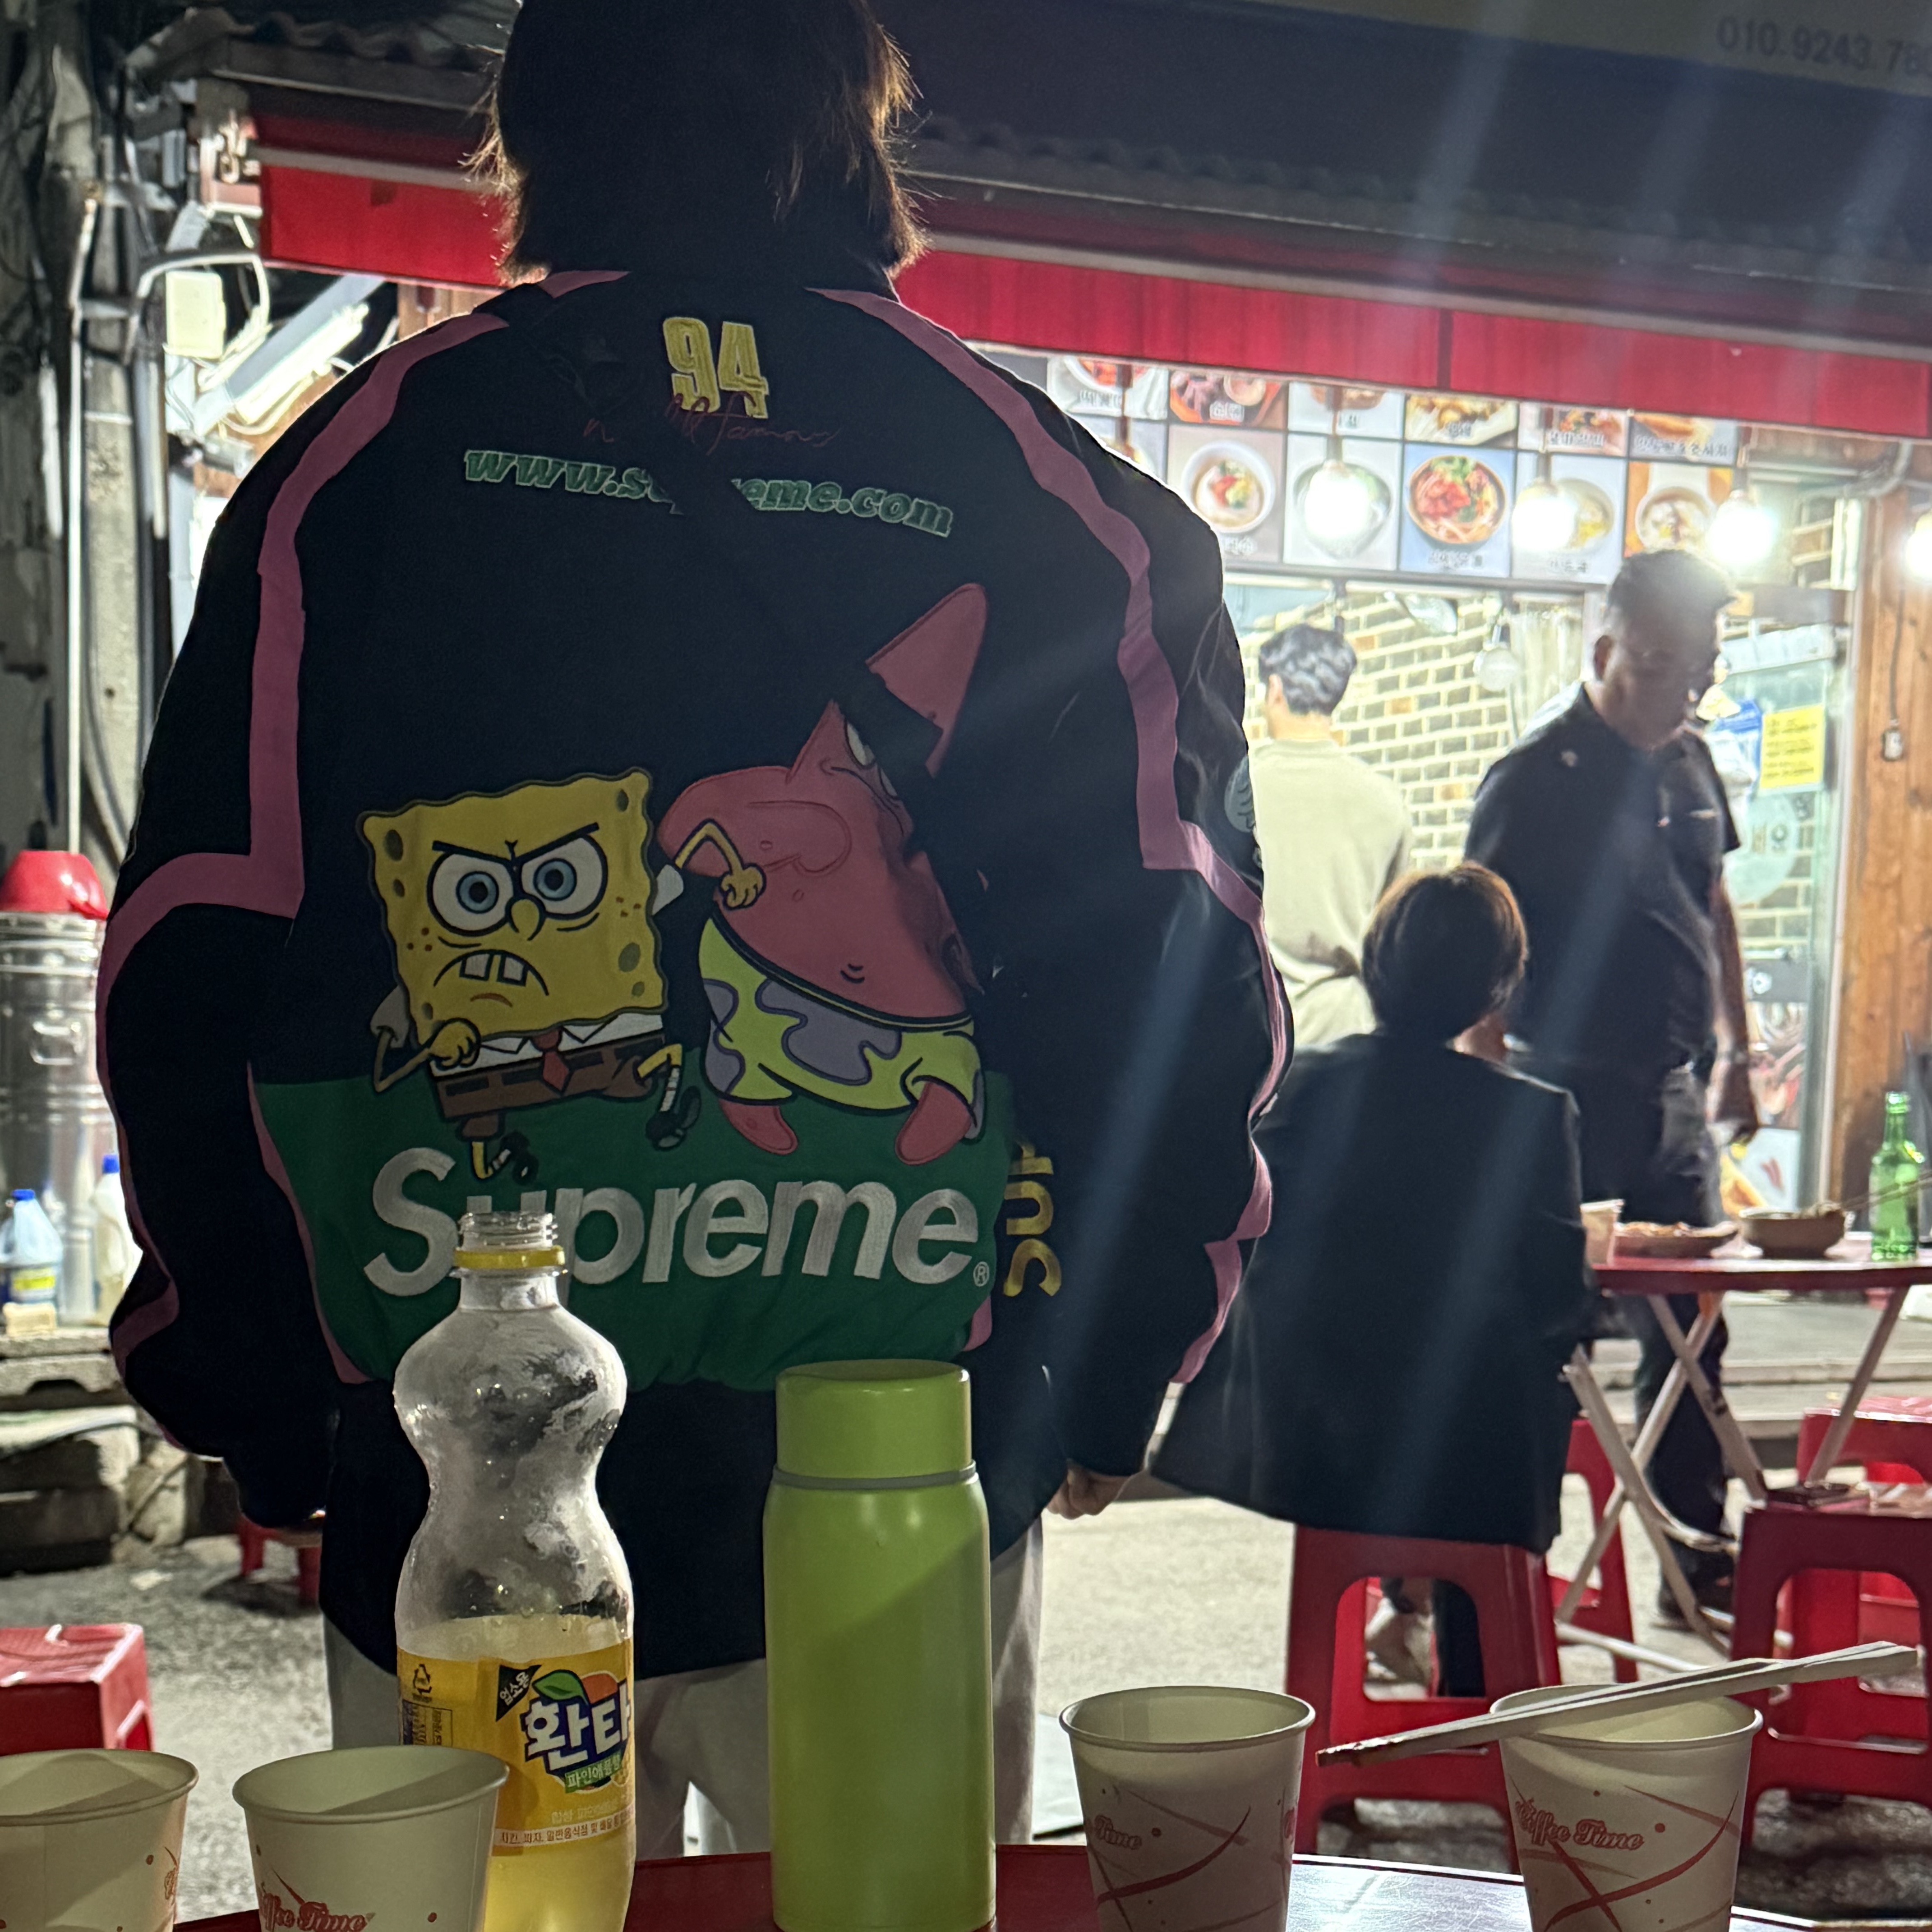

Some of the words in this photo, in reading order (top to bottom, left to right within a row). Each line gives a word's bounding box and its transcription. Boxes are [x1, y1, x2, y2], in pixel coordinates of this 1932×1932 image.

[662, 317, 769, 420] 94
[499, 1671, 530, 1707] 업소용
[525, 1683, 630, 1771] 환타
[567, 1754, 622, 1789] 파인애플향
[1094, 1814, 1143, 1850] Time
[1573, 1818, 1645, 1850] Time
[297, 1900, 368, 1932] Time
